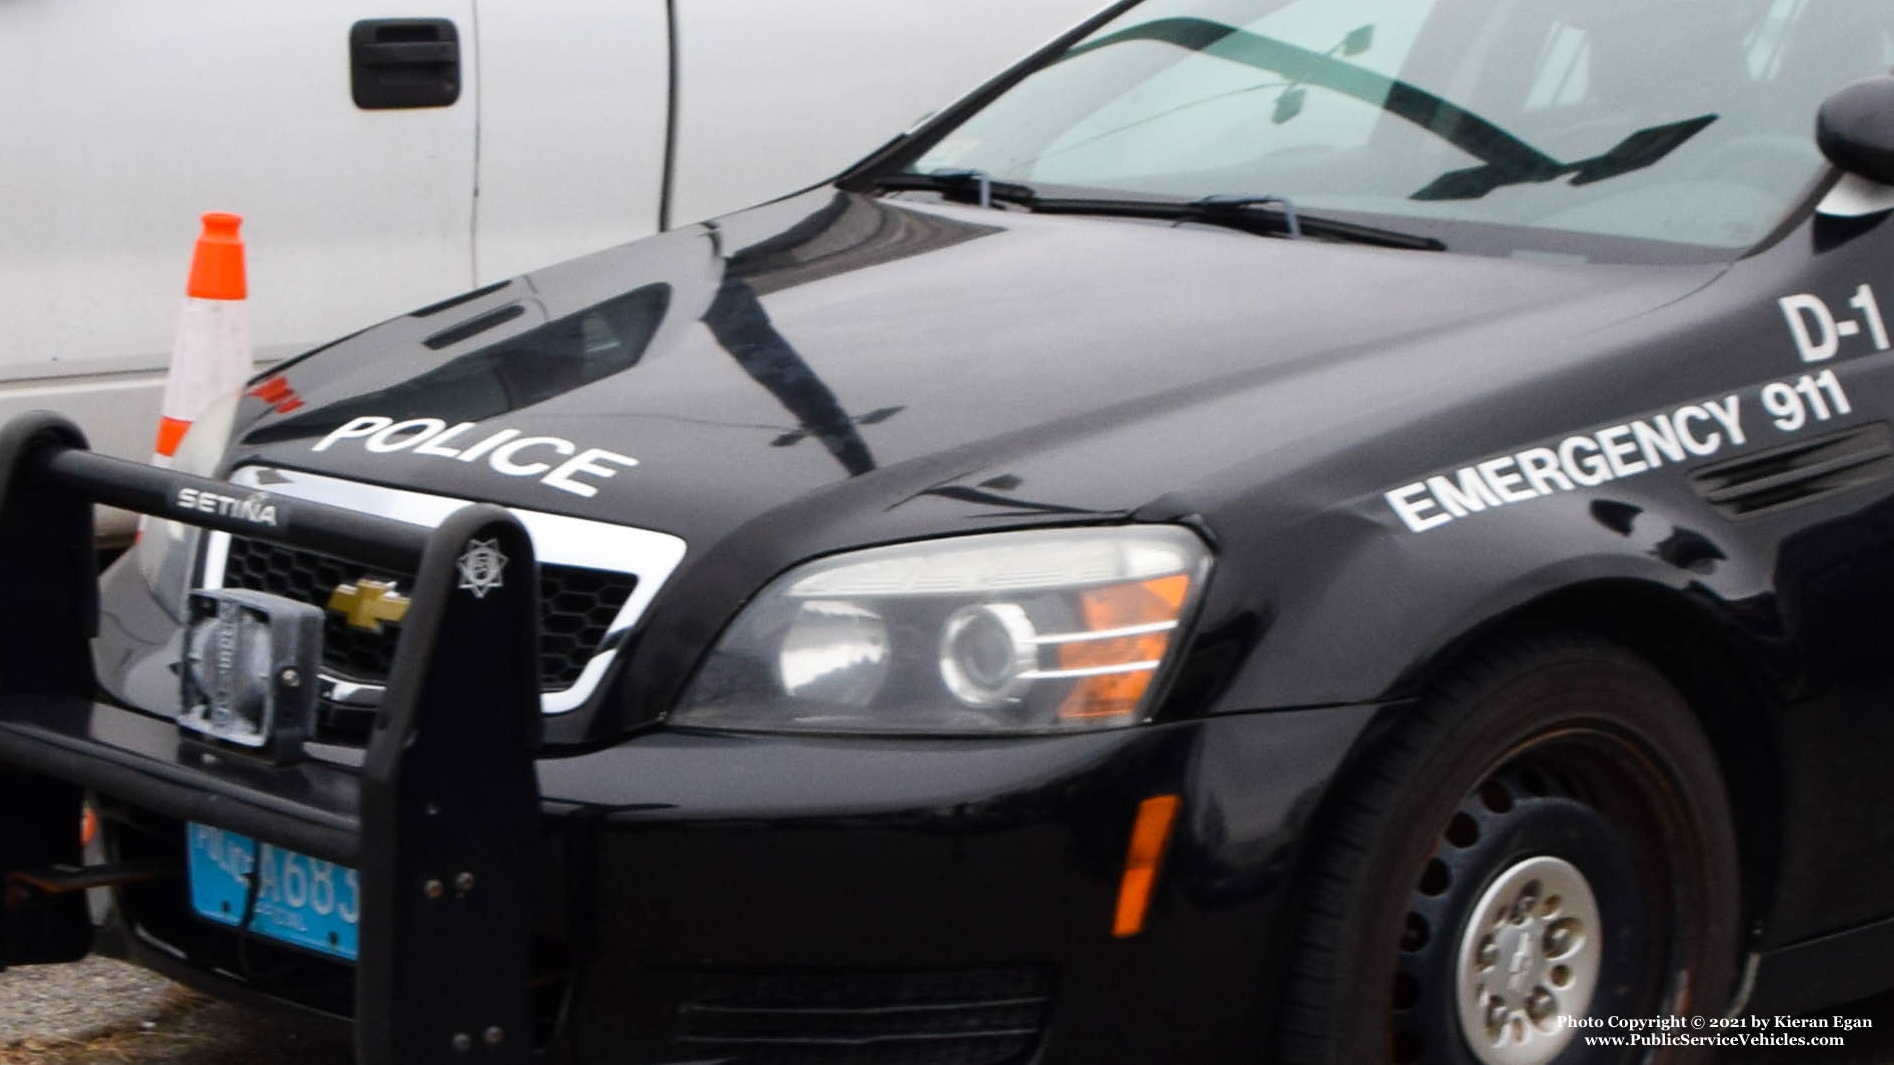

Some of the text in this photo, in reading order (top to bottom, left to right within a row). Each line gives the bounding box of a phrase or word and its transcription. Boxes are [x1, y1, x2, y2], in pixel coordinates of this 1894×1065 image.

[1778, 284, 1891, 363] D-1
[310, 416, 640, 498] POLICE
[1383, 369, 1853, 533] EMERGENCY 911
[177, 487, 277, 527] SETINA
